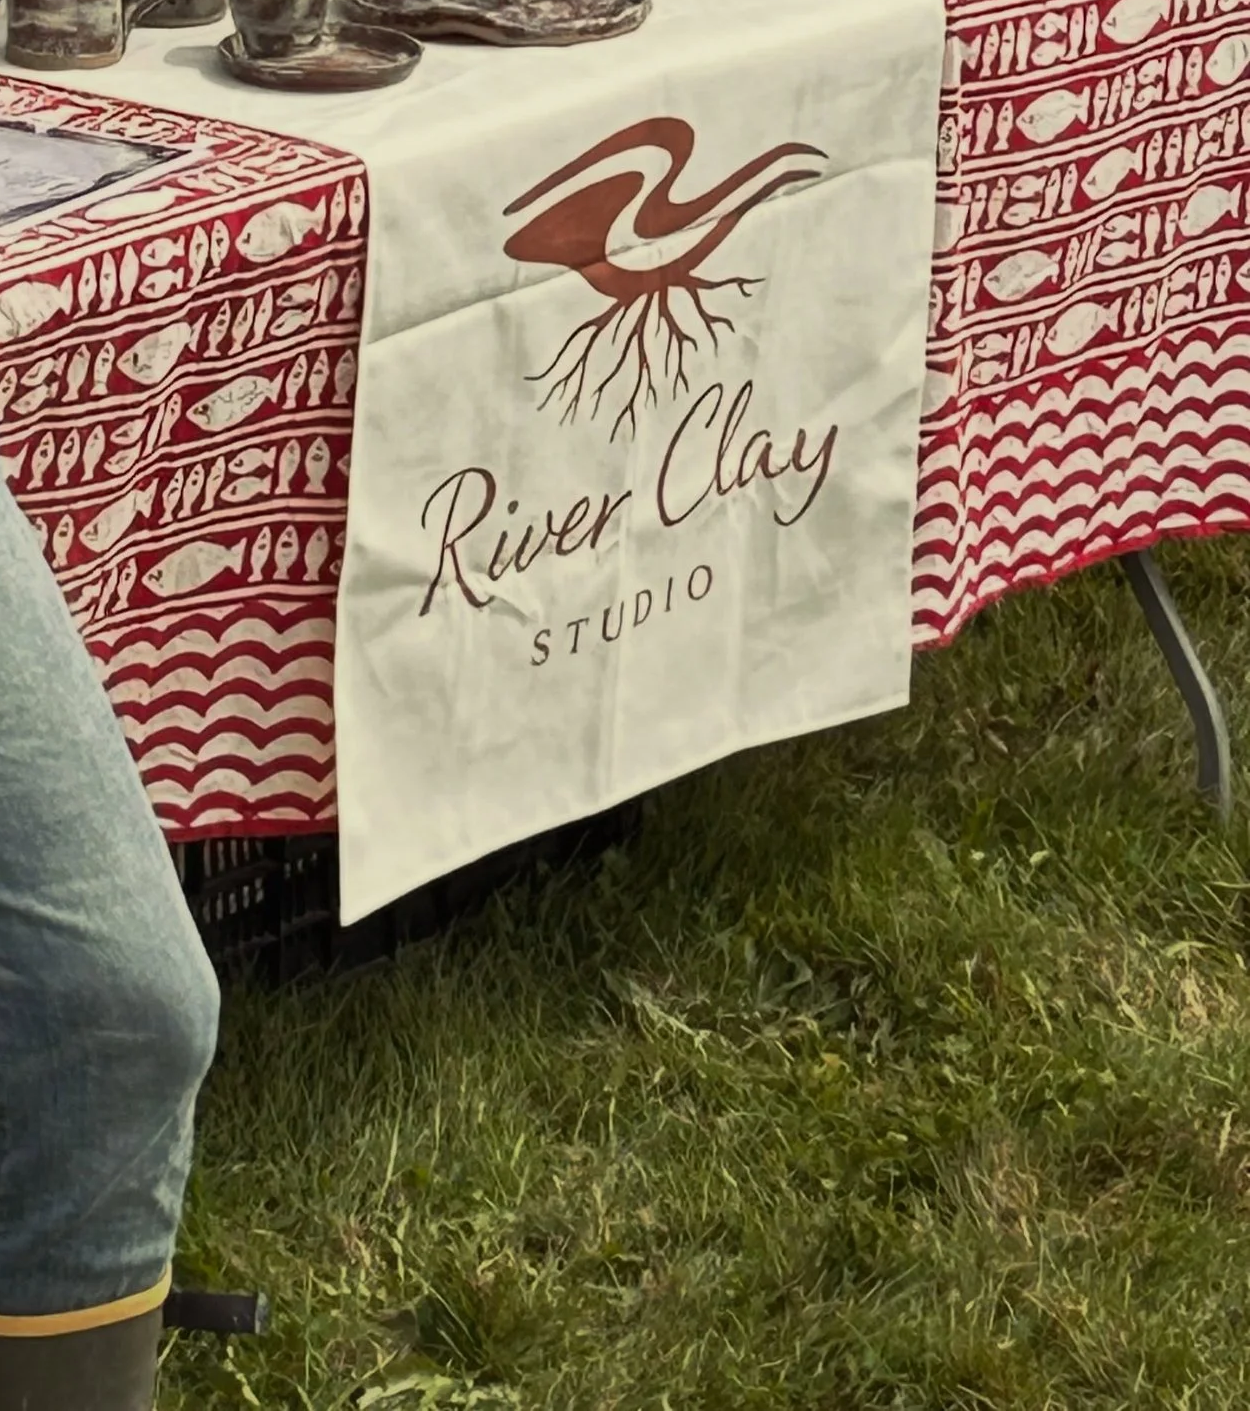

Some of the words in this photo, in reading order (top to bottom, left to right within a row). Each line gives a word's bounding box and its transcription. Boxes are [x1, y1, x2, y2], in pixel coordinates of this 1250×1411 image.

[419, 466, 633, 617] River
[656, 379, 839, 527] Clay
[530, 564, 713, 667] STUDIO
